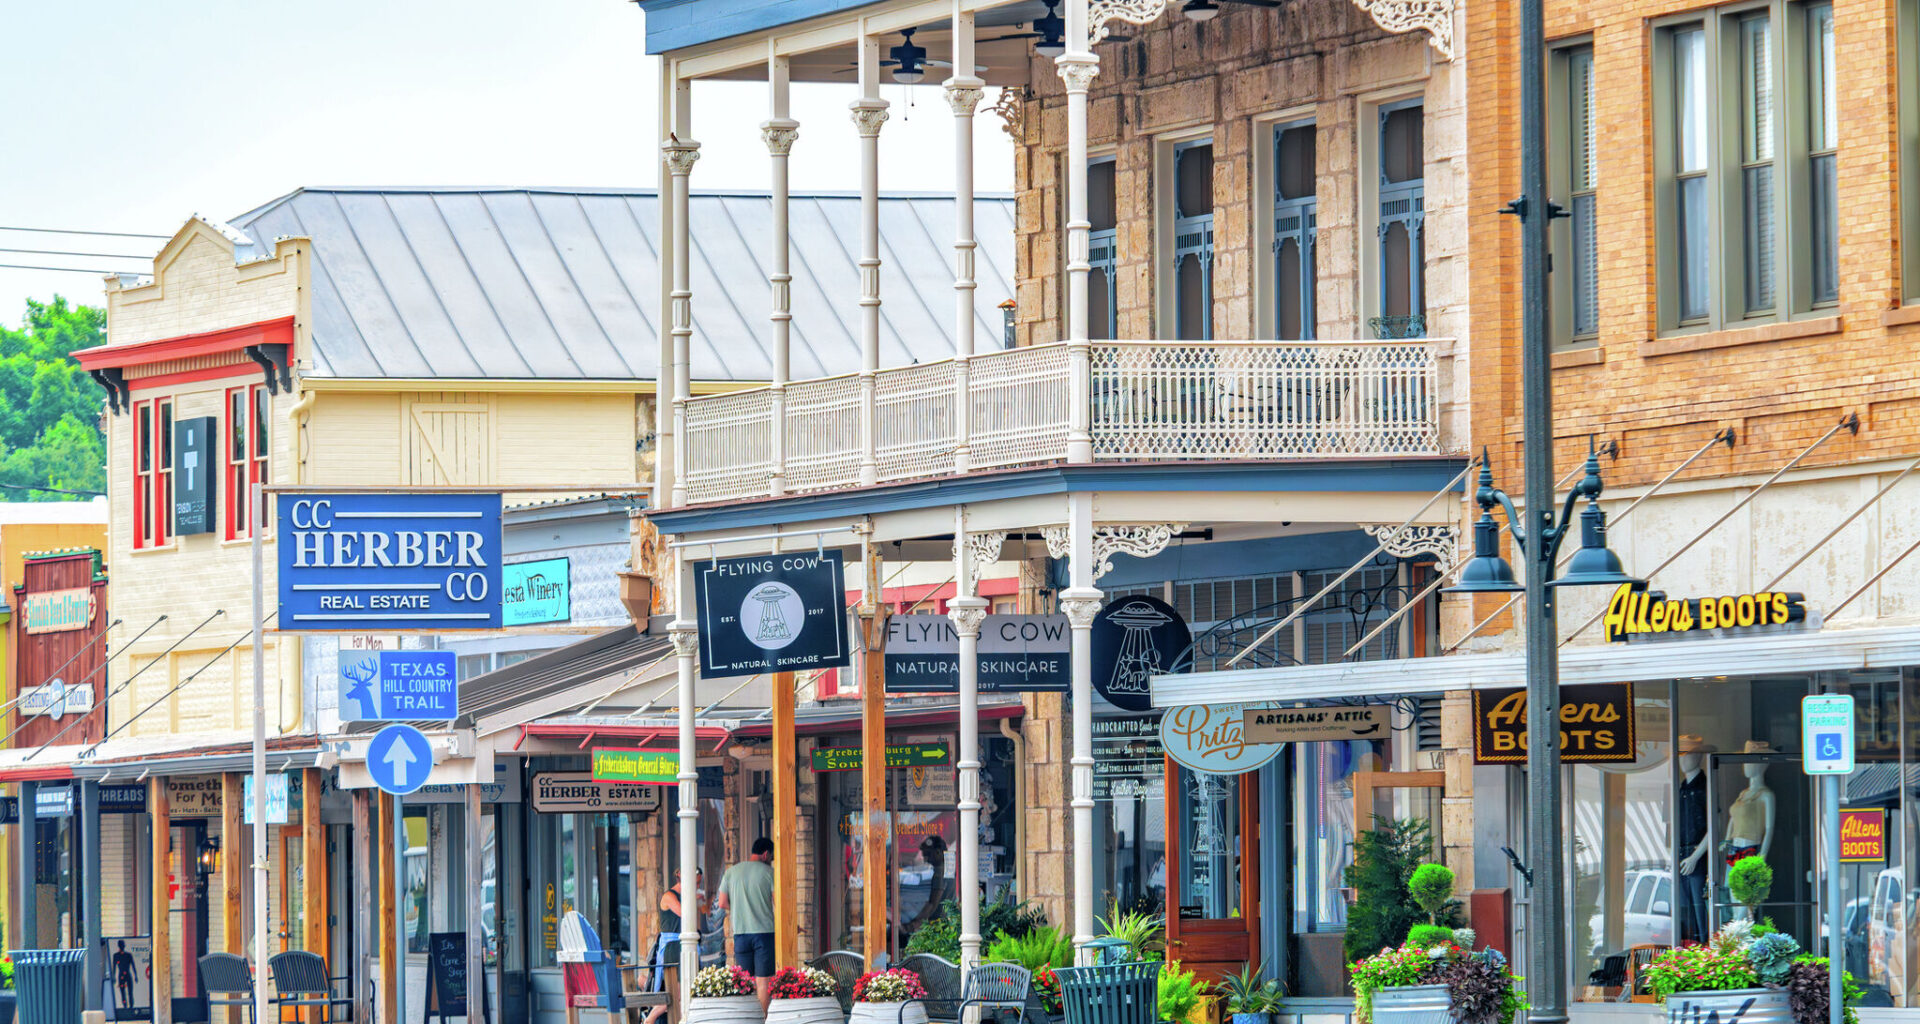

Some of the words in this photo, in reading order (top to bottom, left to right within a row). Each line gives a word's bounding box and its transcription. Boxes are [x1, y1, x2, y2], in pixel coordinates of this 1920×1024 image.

[291, 500, 332, 529] CC
[292, 531, 488, 567] HERBER
[719, 561, 774, 577] FLYING
[782, 557, 819, 571] COW
[446, 572, 488, 601] CO
[320, 596, 364, 609] REAL
[370, 595, 430, 608] ESTATE
[504, 586, 525, 604] esta
[526, 573, 563, 617] Winery
[1604, 582, 1694, 643] Allens
[1699, 592, 1789, 630] BOOTS
[888, 623, 982, 643] FLYIN
[1000, 622, 1064, 642] COW
[390, 663, 446, 676] TEXAS
[731, 659, 771, 670] NATURAL
[777, 655, 819, 667] SKINCARE
[896, 662, 960, 674] NATURA
[981, 660, 1058, 673] SKINCARE
[383, 680, 405, 693] HILL
[409, 679, 453, 693] COUNTRY
[393, 696, 445, 709] TRAIL
[1487, 690, 1621, 729] Aens
[1807, 703, 1848, 714] RESERVED
[1255, 712, 1328, 725] ARTISANS'
[1334, 710, 1373, 722] ATTIC
[1809, 716, 1848, 727] PARKING
[1091, 721, 1139, 733] HANDCRAFTED
[1172, 704, 1244, 761] Pritz
[825, 743, 911, 758] Fredeburg
[826, 758, 911, 769] Souirs
[539, 777, 553, 786] CC
[176, 792, 195, 803] For
[201, 792, 223, 806] Me
[540, 786, 601, 798] HERBER
[608, 788, 651, 799] ESTATE
[587, 798, 601, 807] CO
[1841, 815, 1881, 840] Allens
[1843, 842, 1880, 855] BOOTS
